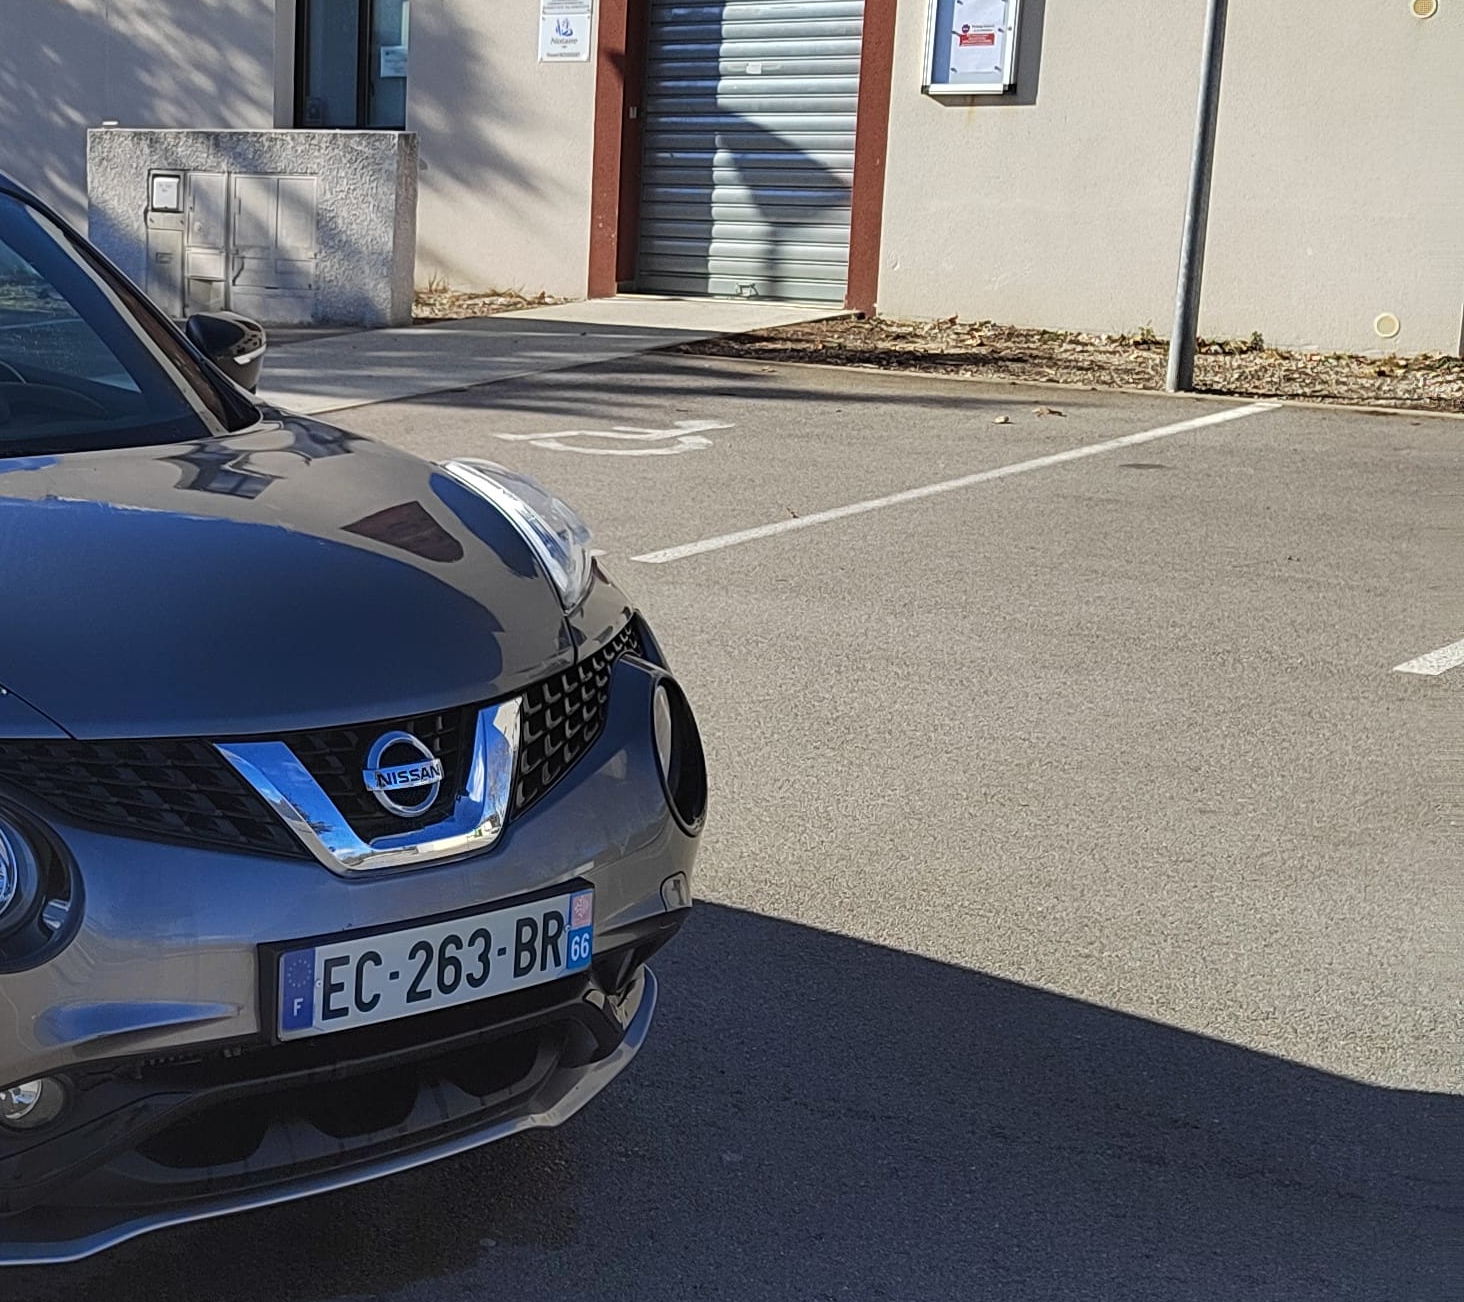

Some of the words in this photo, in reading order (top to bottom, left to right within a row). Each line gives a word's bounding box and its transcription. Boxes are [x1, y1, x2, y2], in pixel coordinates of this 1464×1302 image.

[376, 764, 441, 787] NISSAN
[571, 932, 591, 962] 66
[321, 910, 566, 1021] EC-263-BR
[293, 997, 304, 1017] F
